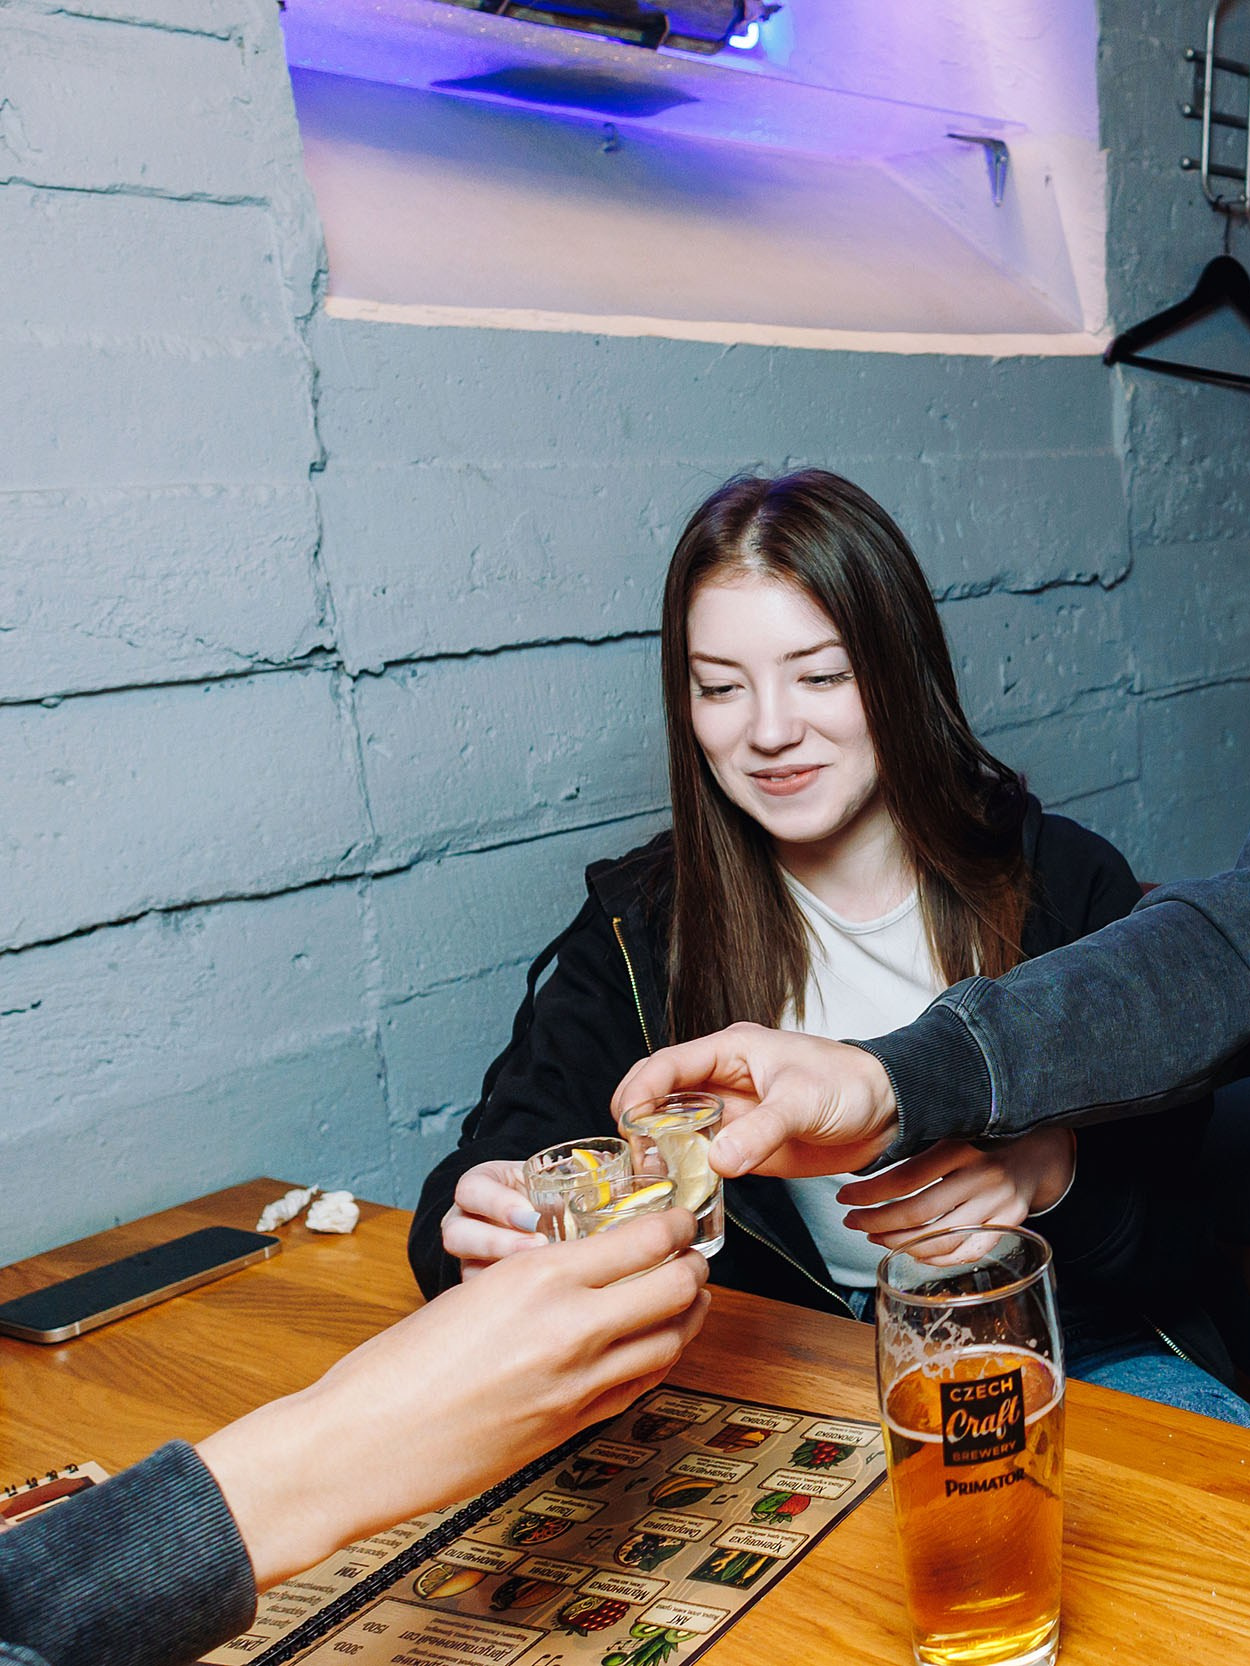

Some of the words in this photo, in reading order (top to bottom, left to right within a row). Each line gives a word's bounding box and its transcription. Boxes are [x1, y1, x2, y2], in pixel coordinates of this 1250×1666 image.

[950, 1377, 1013, 1402] CZECH
[945, 1394, 1020, 1444] Craft
[952, 1440, 1016, 1462] BREWERY
[643, 1520, 701, 1538] Смородина
[728, 1535, 785, 1554] Хреновуха
[444, 1548, 511, 1571] Лимончелло
[333, 1566, 363, 1579] РОМ
[588, 1581, 650, 1601] Малиновка
[666, 1614, 692, 1626] АКГ
[414, 1635, 513, 1662] Дегустационный
